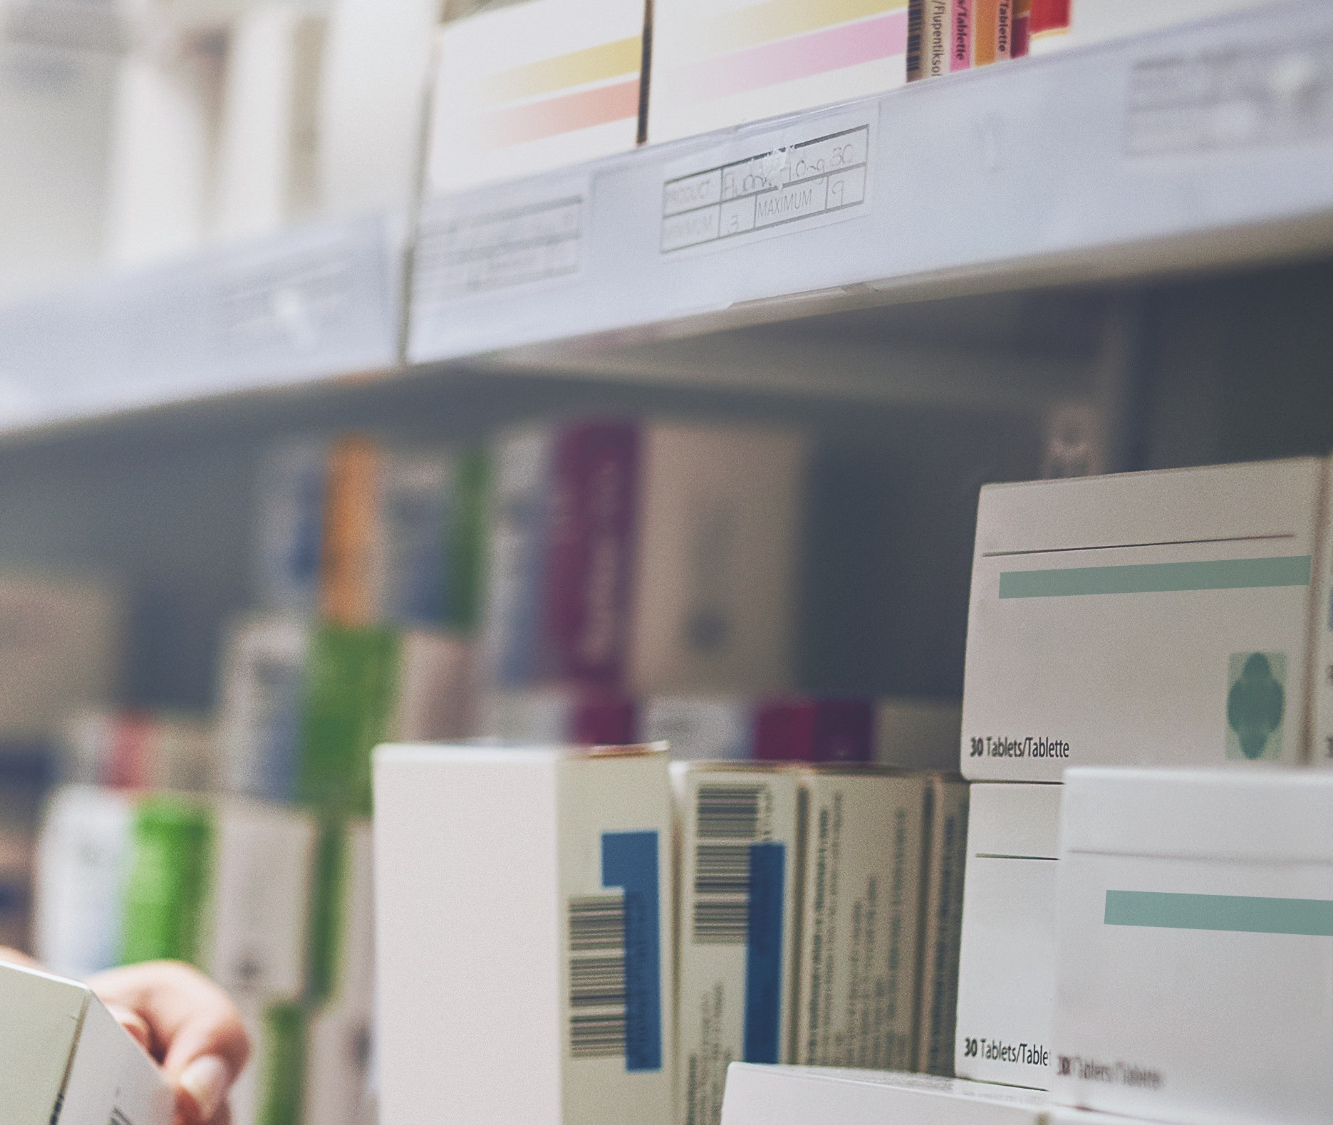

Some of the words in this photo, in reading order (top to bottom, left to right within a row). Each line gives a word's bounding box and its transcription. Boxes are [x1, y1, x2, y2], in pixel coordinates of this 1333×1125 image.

[757, 189, 813, 217] MAXIMUM
[970, 736, 984, 757] 30
[986, 736, 1070, 758] Tablets/Tablette
[964, 1037, 978, 1057] 30
[980, 1038, 1051, 1066] Tablets/Table
